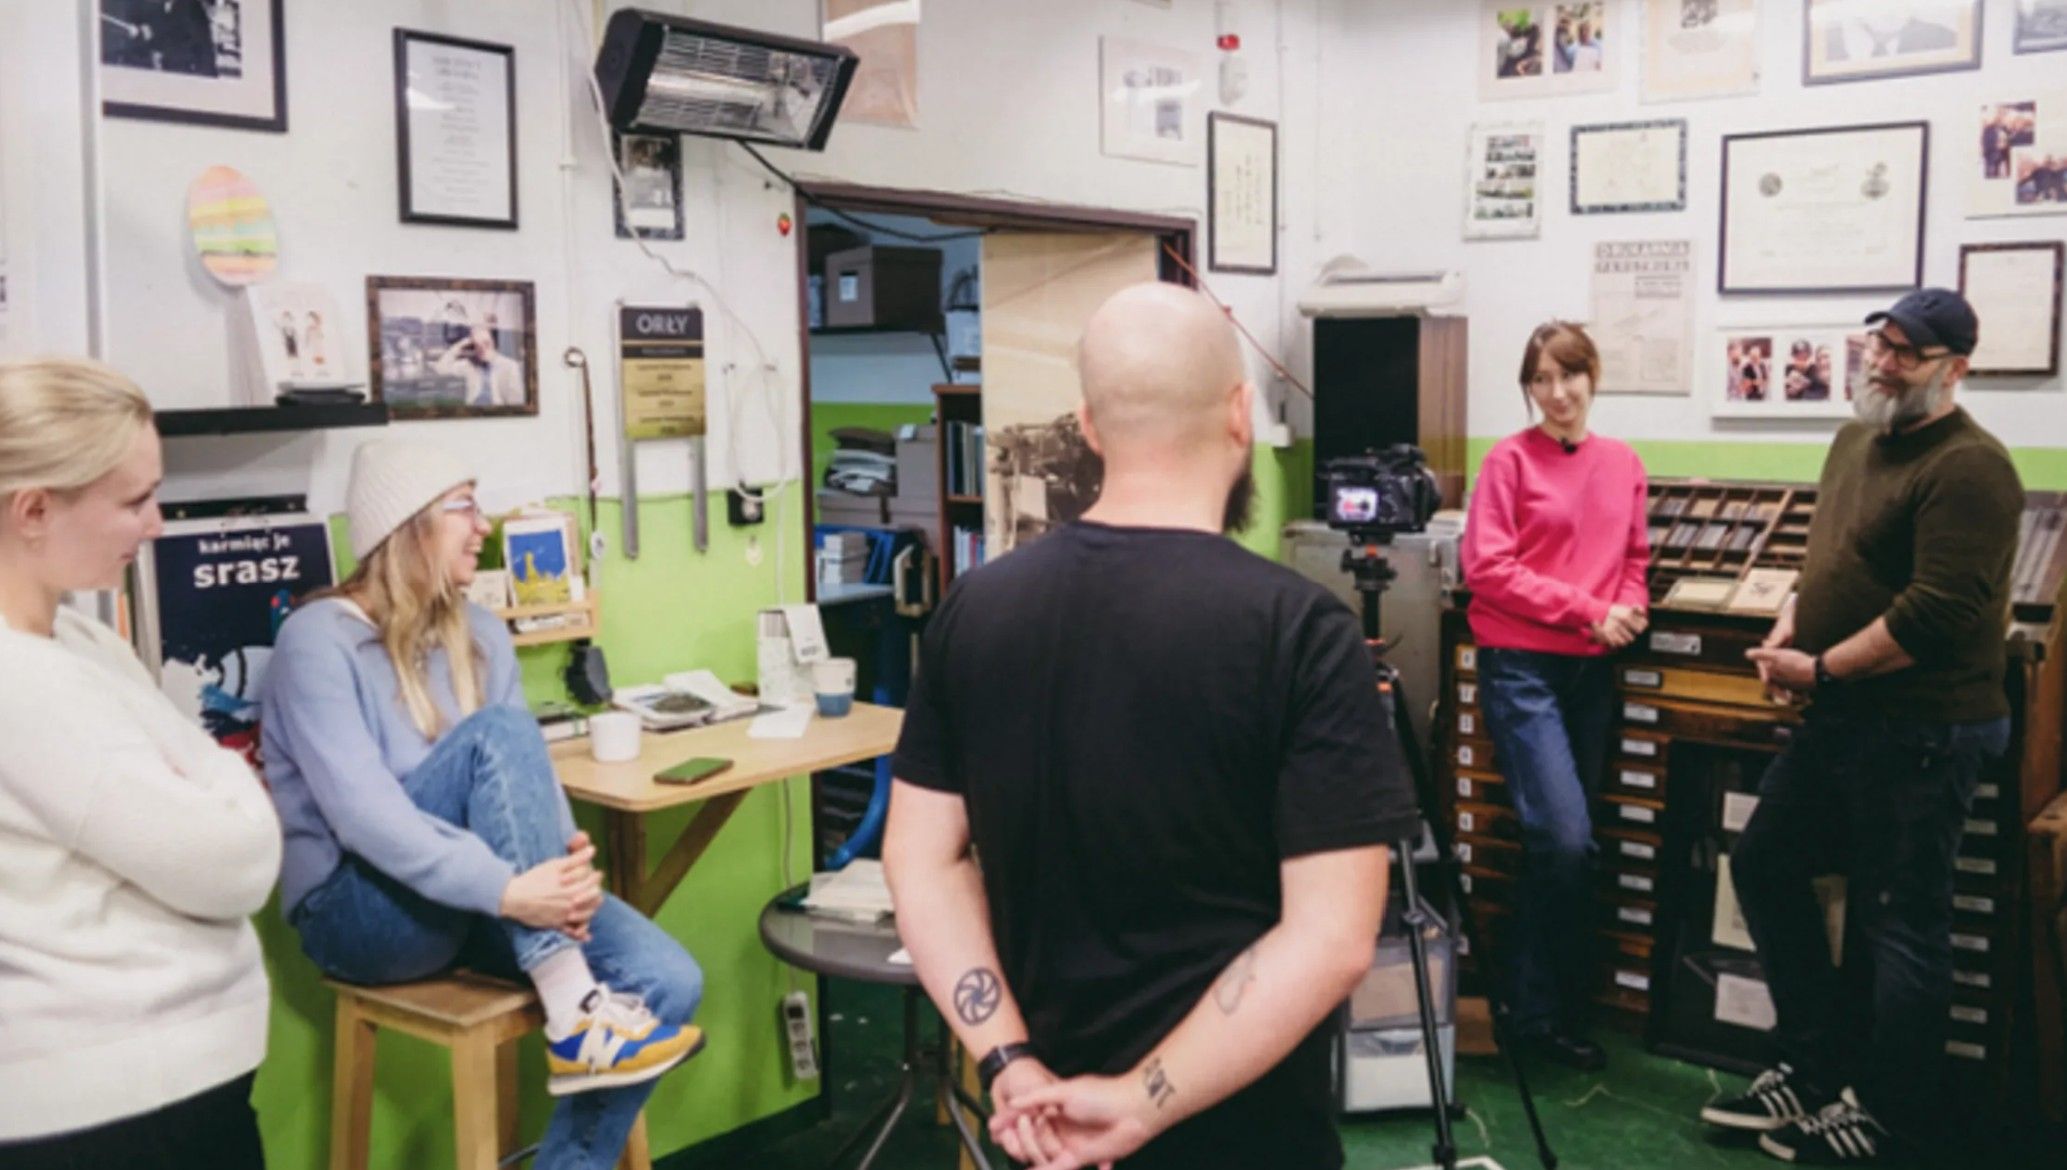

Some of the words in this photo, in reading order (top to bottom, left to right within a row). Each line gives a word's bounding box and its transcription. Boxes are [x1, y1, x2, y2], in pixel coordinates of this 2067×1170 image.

[635, 312, 688, 334] ORŁY
[273, 532, 291, 551] je
[193, 555, 301, 588] srasz
